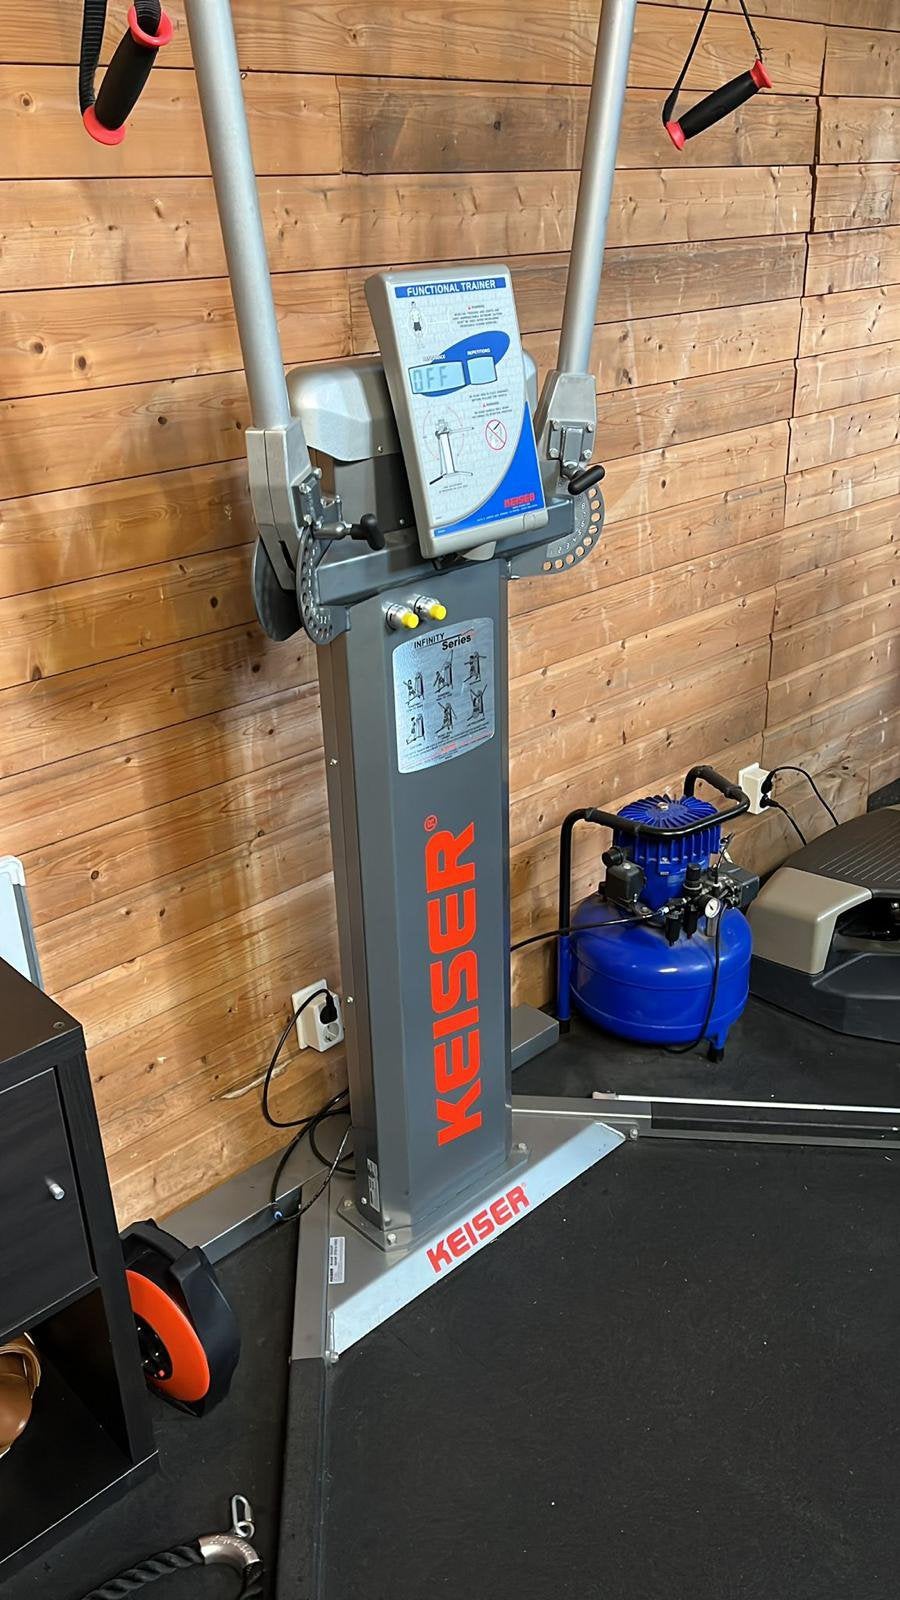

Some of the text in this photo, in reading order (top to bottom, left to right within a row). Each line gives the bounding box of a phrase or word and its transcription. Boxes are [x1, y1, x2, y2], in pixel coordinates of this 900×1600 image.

[406, 279, 496, 297] FUNCTIONAL TRAINER
[413, 366, 447, 392] OFF
[414, 632, 445, 649] INFINITY
[442, 635, 472, 651] Series
[426, 1185, 530, 1274] KEISER
